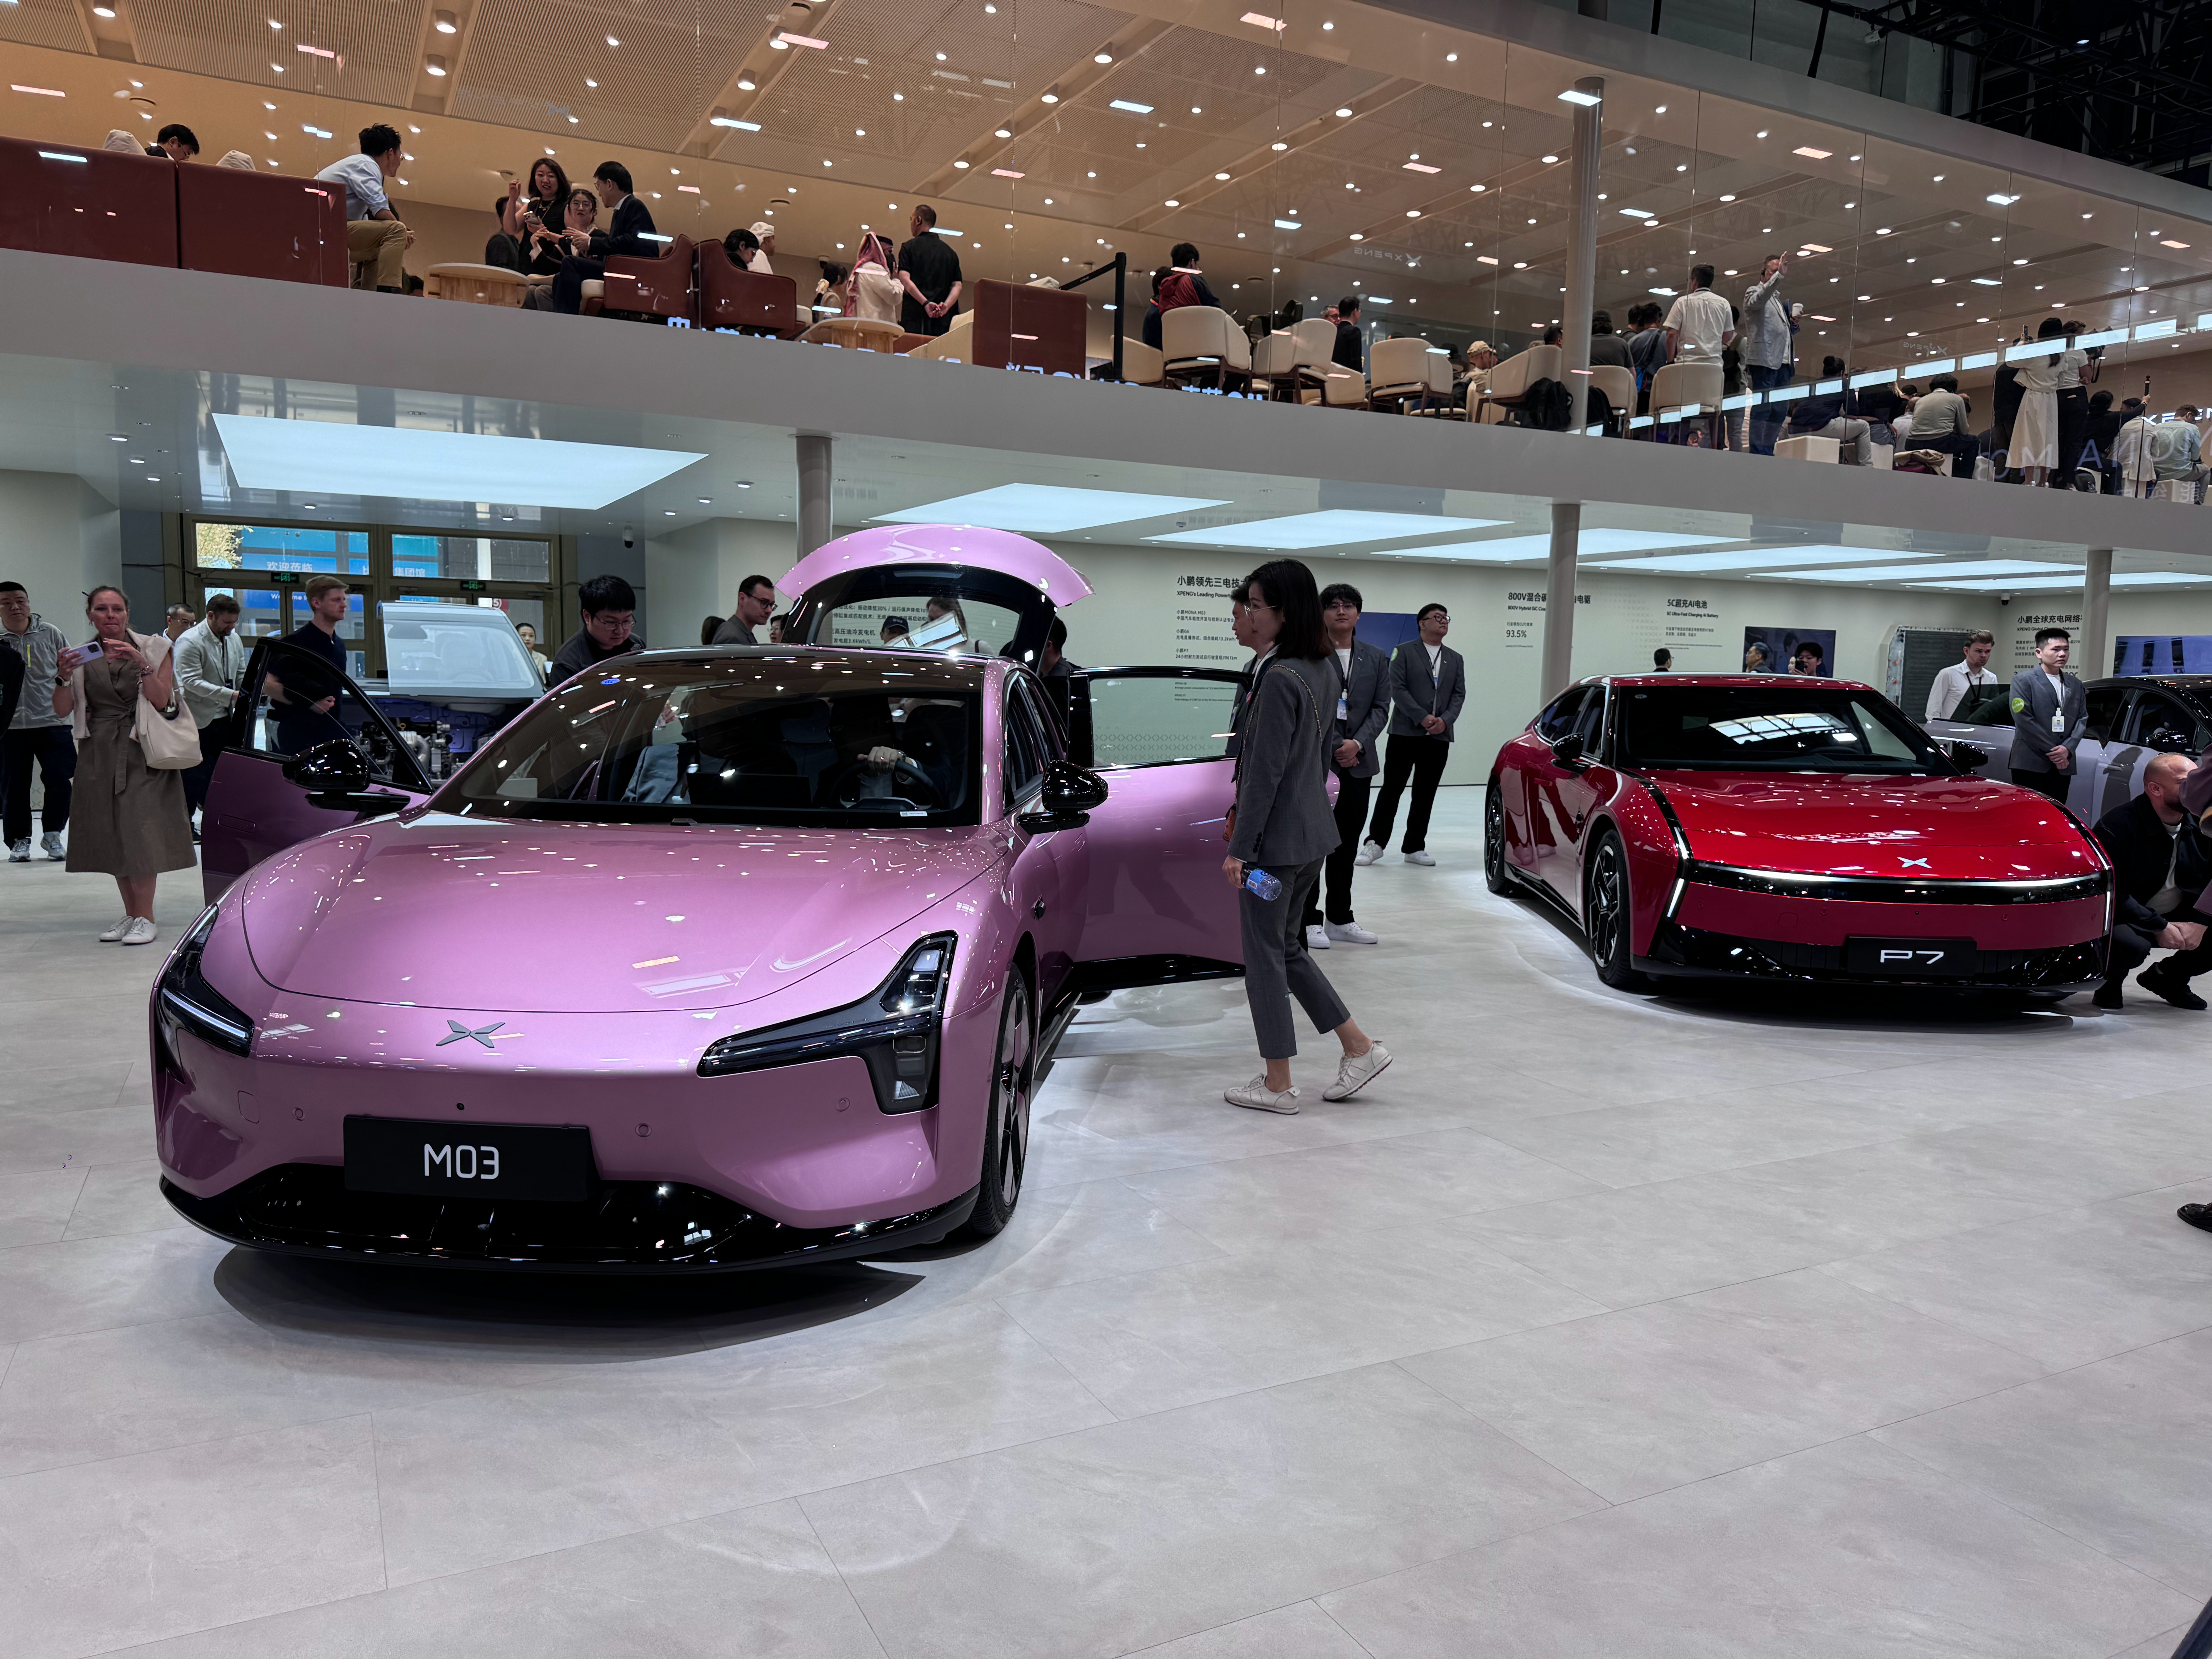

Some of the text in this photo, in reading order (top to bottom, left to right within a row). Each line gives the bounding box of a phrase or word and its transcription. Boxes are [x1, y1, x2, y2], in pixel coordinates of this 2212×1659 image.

[1177, 575, 1244, 588] 小鹏领先三电技
[1574, 595, 1591, 604] 电驱
[1667, 599, 1707, 609] 5C超充AI电池
[1506, 630, 1527, 638] 93.5%
[1880, 950, 1944, 964] P7
[424, 1143, 499, 1180] M03
